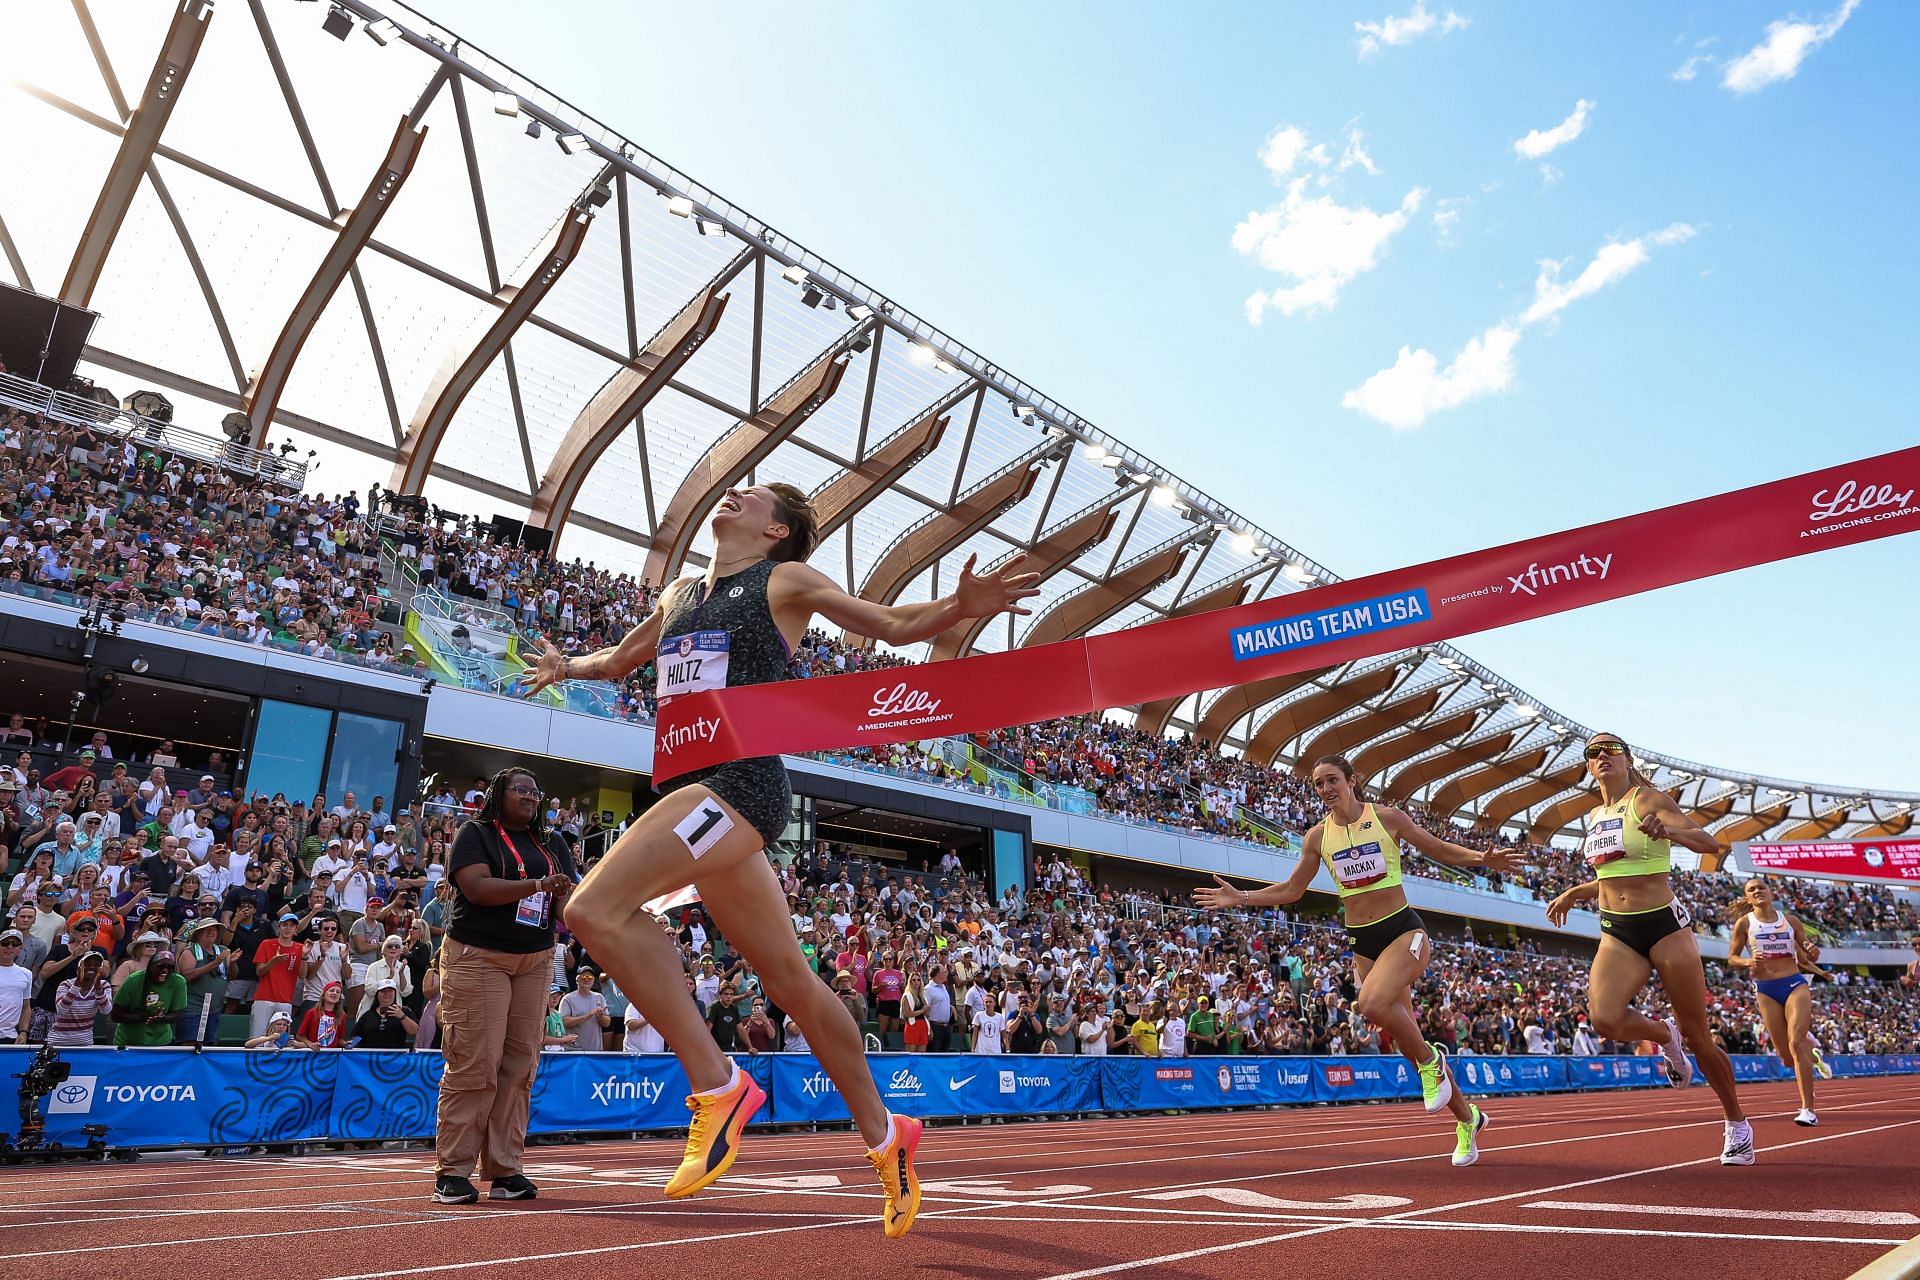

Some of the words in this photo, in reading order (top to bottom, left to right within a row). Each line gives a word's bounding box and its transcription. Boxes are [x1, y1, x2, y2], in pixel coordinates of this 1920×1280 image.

[1809, 480, 1915, 521] Lilly
[1810, 516, 1873, 536] MEDICINE
[1440, 587, 1489, 606] presented
[1490, 584, 1504, 594] by
[1506, 552, 1613, 596] xfinity
[1236, 619, 1315, 655] MAKING
[1317, 606, 1373, 637] TEAM
[1377, 595, 1424, 624] USA
[667, 659, 703, 687] HILTZ
[867, 682, 942, 717] Lilly
[864, 719, 909, 730] MEDICINE
[909, 713, 954, 725] COMPANY
[661, 716, 721, 755] xfinity
[687, 807, 725, 847] 1
[1586, 843, 1594, 853] ST
[1594, 834, 1618, 850] PIERRE
[1343, 859, 1376, 877] MACKAY
[1676, 904, 1689, 921] 4
[1762, 943, 1788, 951] JOHNSON
[1156, 1070, 1173, 1079] MAKING
[1173, 1070, 1184, 1078] TEAM
[1184, 1069, 1193, 1078] USA
[1233, 1065, 1241, 1073] U.S.
[1242, 1065, 1260, 1074] OLYMPIC
[1233, 1074, 1246, 1083] TEAM
[1246, 1074, 1260, 1083] TRIALS
[1288, 1074, 1309, 1084] USATF
[1328, 1071, 1341, 1082] TEAM
[1341, 1070, 1352, 1081] USA
[889, 1069, 924, 1092] Lilly
[1017, 1076, 1051, 1087] TOYOTA
[103, 1085, 196, 1103] TOYOTA
[591, 1075, 664, 1106] xfinity
[897, 1147, 911, 1200] NITRO
